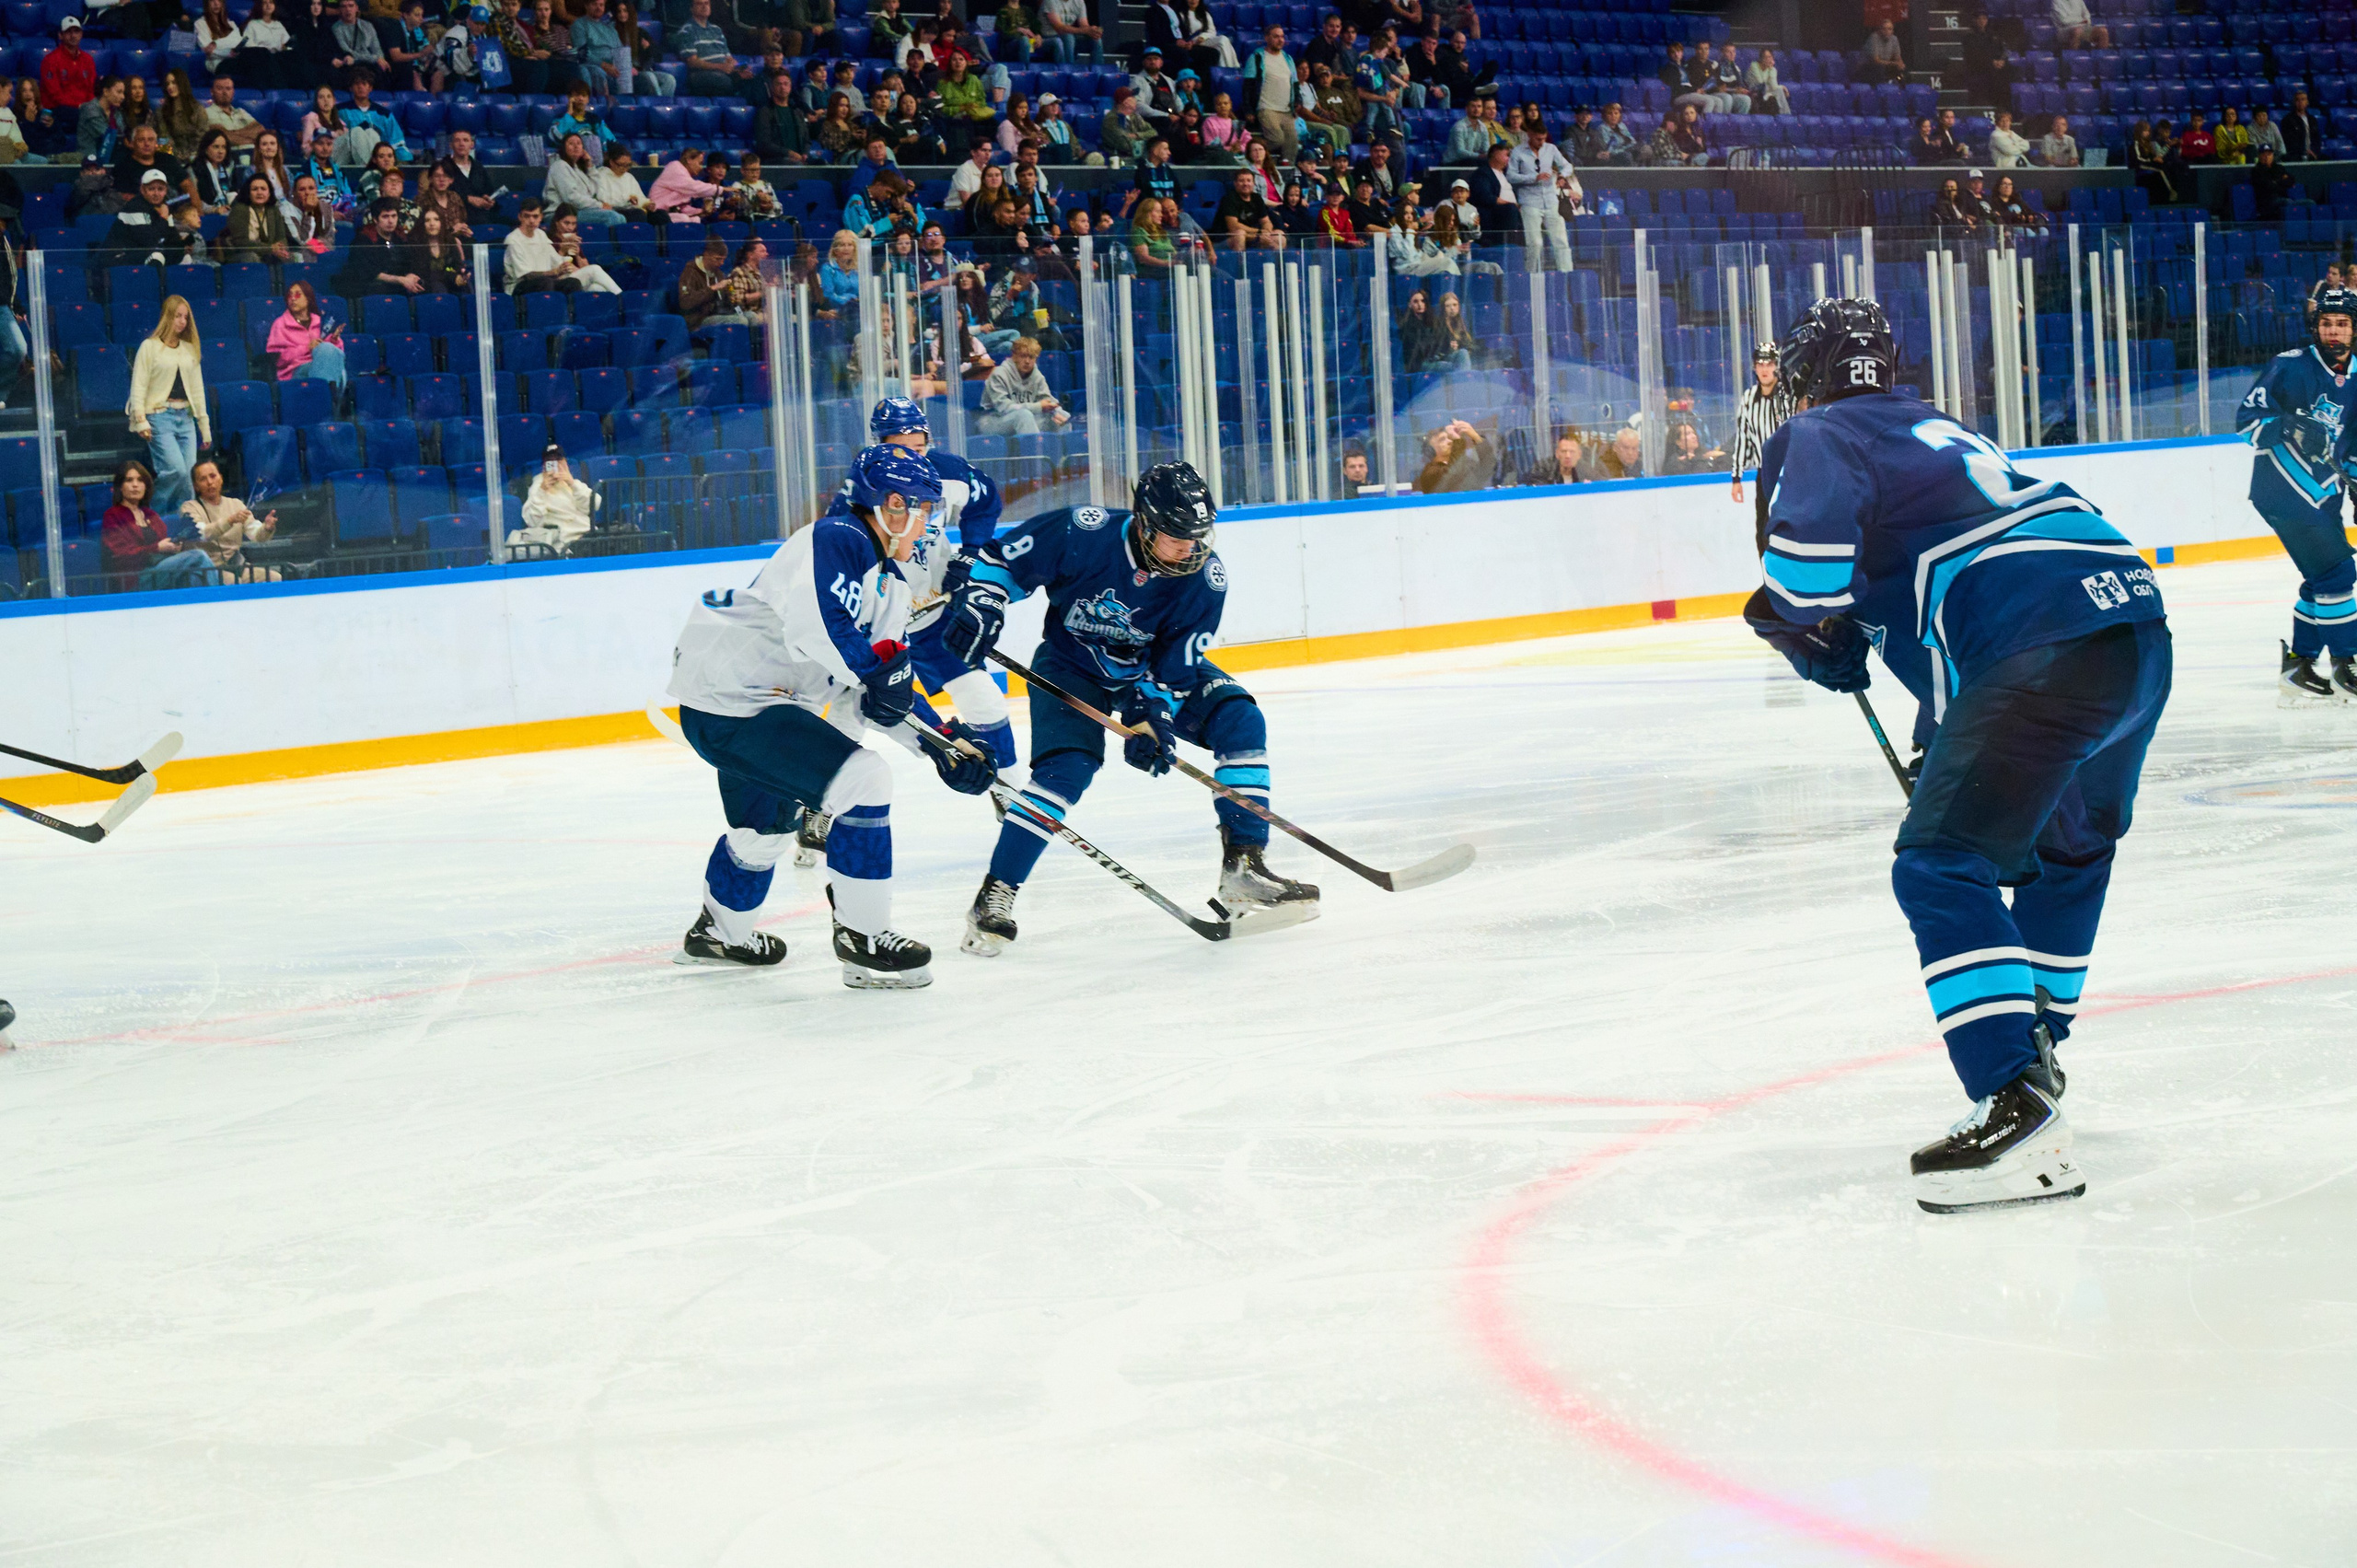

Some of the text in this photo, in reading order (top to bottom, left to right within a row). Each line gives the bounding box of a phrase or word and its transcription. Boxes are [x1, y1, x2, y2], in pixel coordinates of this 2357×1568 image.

[1945, 17, 1959, 29] 16
[1850, 360, 1876, 385] 26
[2243, 386, 2269, 408] 33
[1911, 419, 2060, 509] 2
[1191, 501, 1209, 519] 19
[830, 572, 864, 619] 48
[1184, 631, 1214, 667] 19
[1868, 715, 1887, 747] NEXUS
[1058, 828, 1147, 896] SOYUZ
[1980, 1122, 2018, 1150] BAUER
